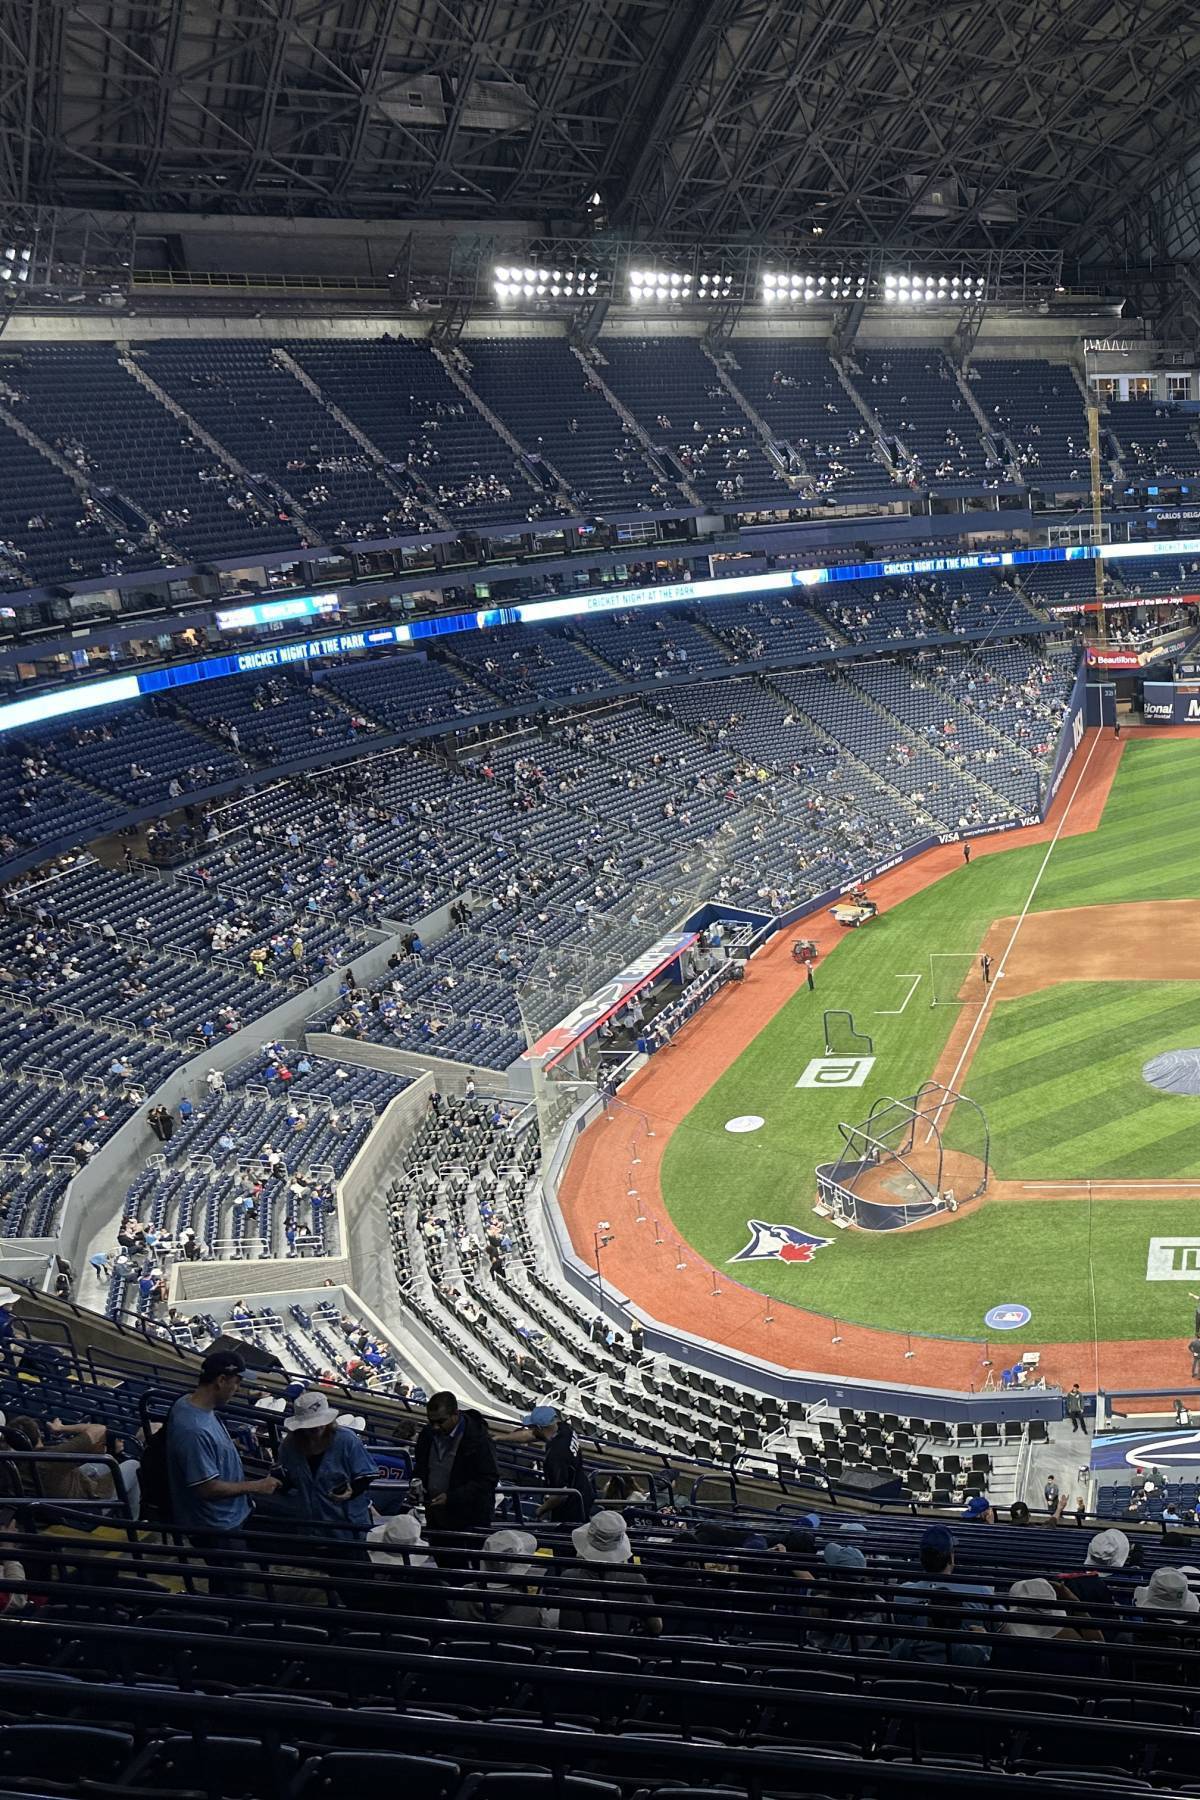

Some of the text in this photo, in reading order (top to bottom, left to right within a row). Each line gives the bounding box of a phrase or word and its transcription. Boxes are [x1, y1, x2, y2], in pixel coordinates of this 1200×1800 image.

[884, 556, 978, 575] CRICKET NIGHT AT THE PARK
[588, 595, 620, 608] CRICKET
[622, 593, 645, 604] NIGHT
[648, 591, 656, 600] AT
[659, 588, 672, 599] THE
[238, 634, 365, 670] CRICKET NIGHT AT THE PARK
[1020, 815, 1040, 827] VISA
[938, 832, 960, 844] VISA
[814, 1061, 861, 1083] TD
